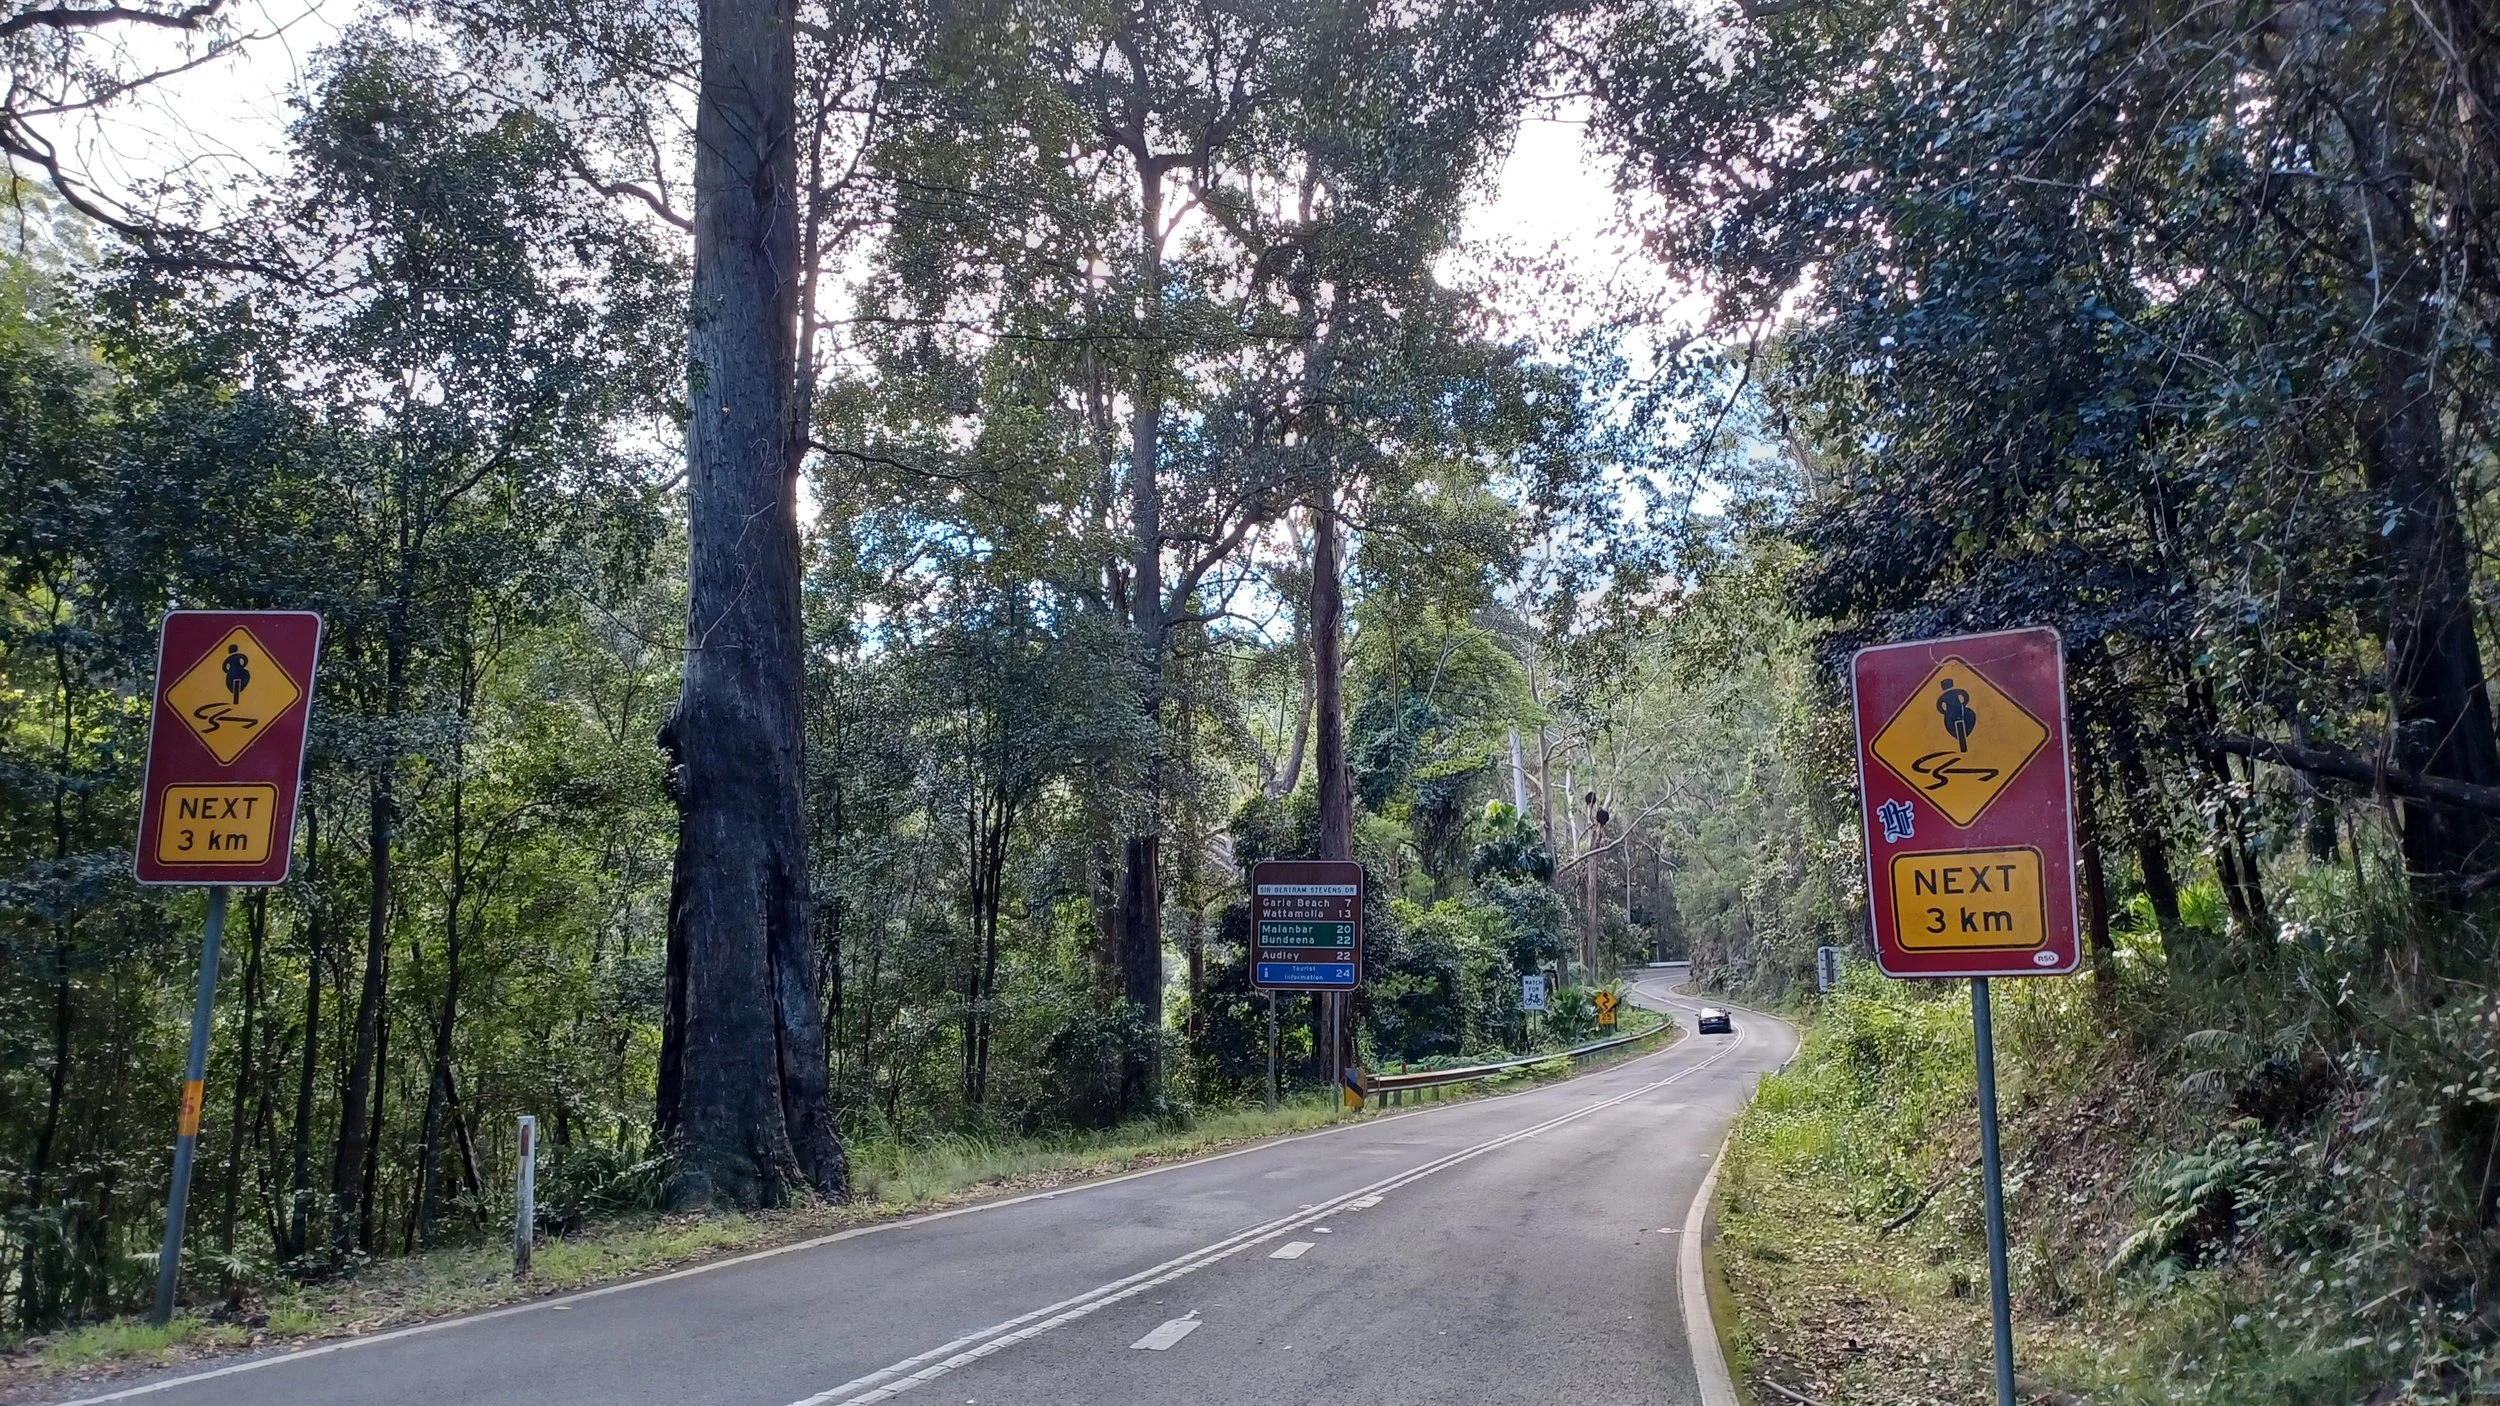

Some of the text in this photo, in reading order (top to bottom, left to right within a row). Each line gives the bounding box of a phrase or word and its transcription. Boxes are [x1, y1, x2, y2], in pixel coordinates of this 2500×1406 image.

[179, 798, 258, 819] NEXT
[177, 829, 248, 851] 3 km
[1914, 865, 2016, 896] NEXT
[1297, 899, 1330, 908] Beach
[1344, 898, 1352, 907] 7
[1262, 909, 1352, 918] Wattamolla 13
[1926, 907, 2013, 934] 3 km
[1336, 925, 1351, 934] 20
[1261, 935, 1351, 945] Bundeena 22
[1261, 950, 1351, 961] Audley 22
[1336, 969, 1350, 978] 24
